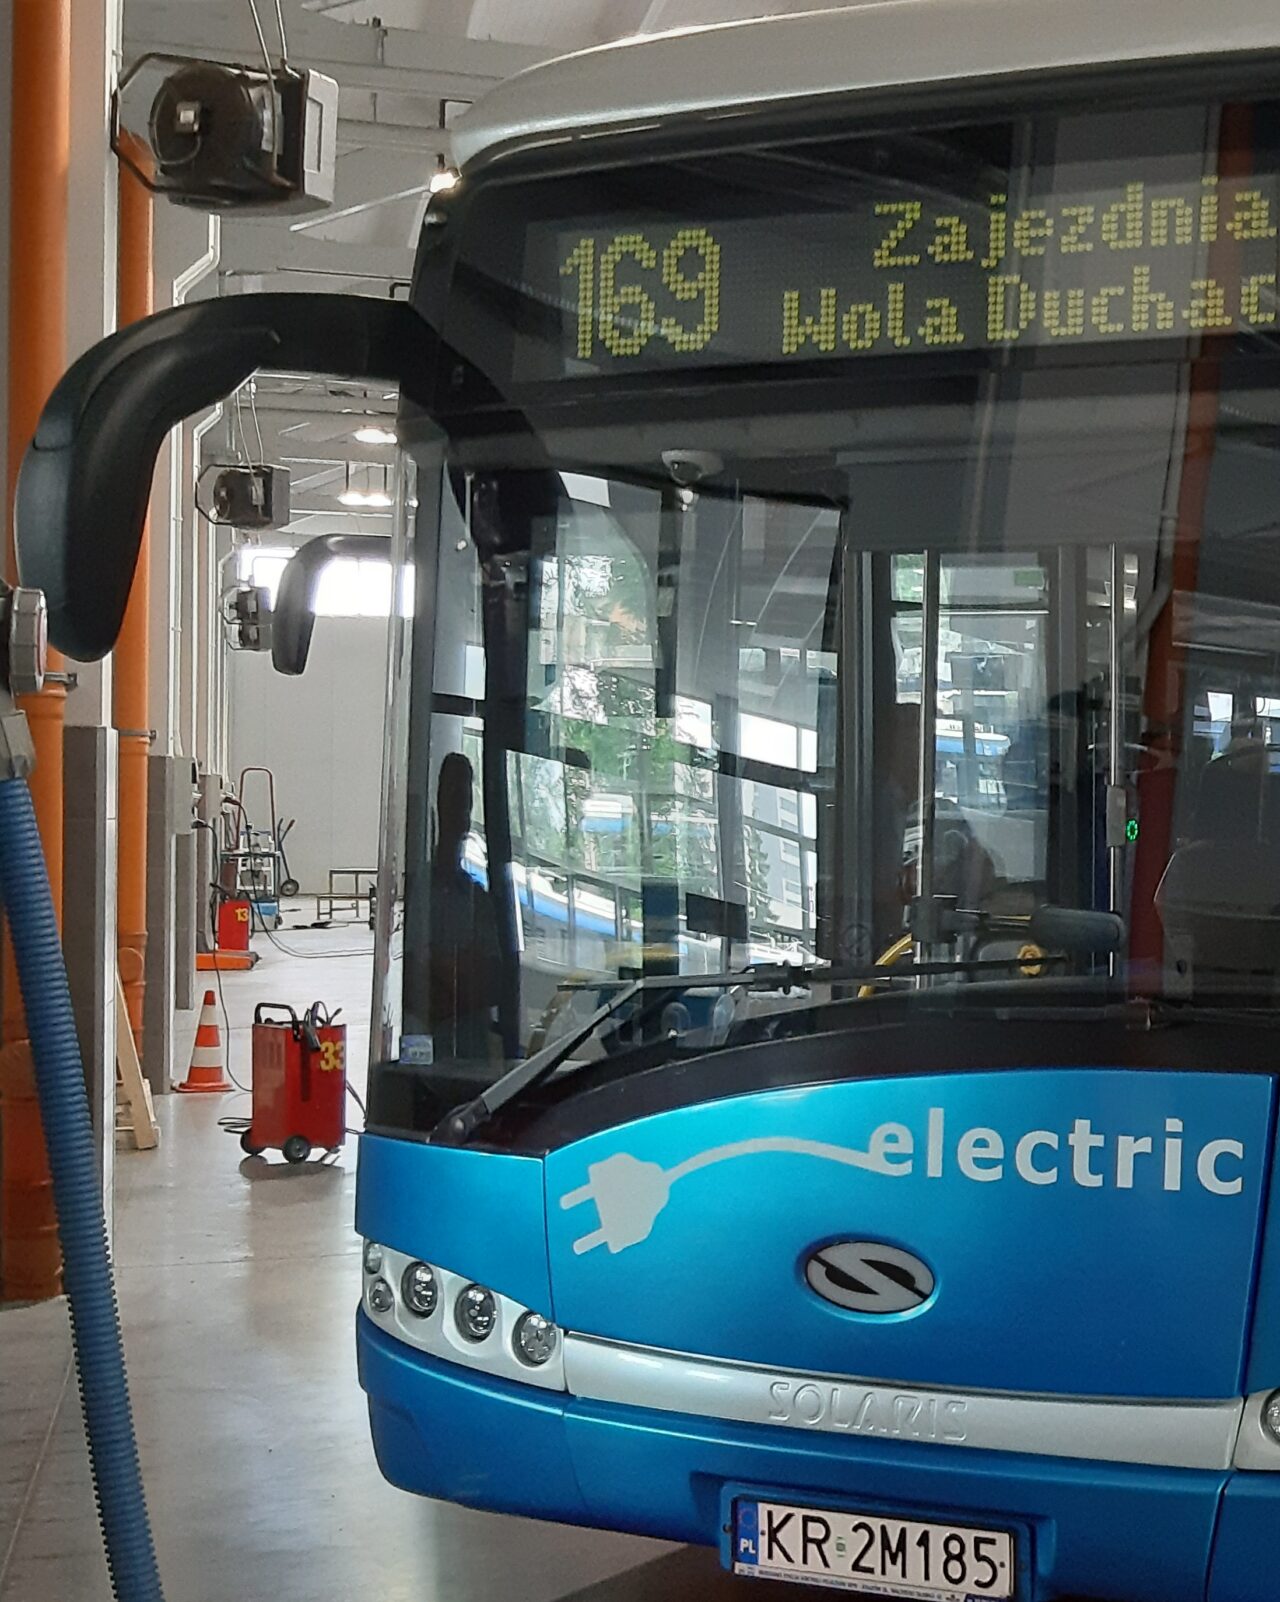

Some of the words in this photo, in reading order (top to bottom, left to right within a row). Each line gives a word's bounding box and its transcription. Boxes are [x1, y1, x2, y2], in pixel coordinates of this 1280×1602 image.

[873, 176, 1277, 269] Zajezdnia
[559, 227, 722, 359] 169
[782, 281, 965, 355] Wola
[236, 907, 249, 922] 13
[319, 1041, 346, 1072] 33
[867, 1107, 1245, 1196] electric
[768, 1380, 968, 1442] SOLARIS
[740, 1538, 756, 1555] PL
[766, 1509, 832, 1569] KR
[850, 1520, 999, 1590] 2M185
